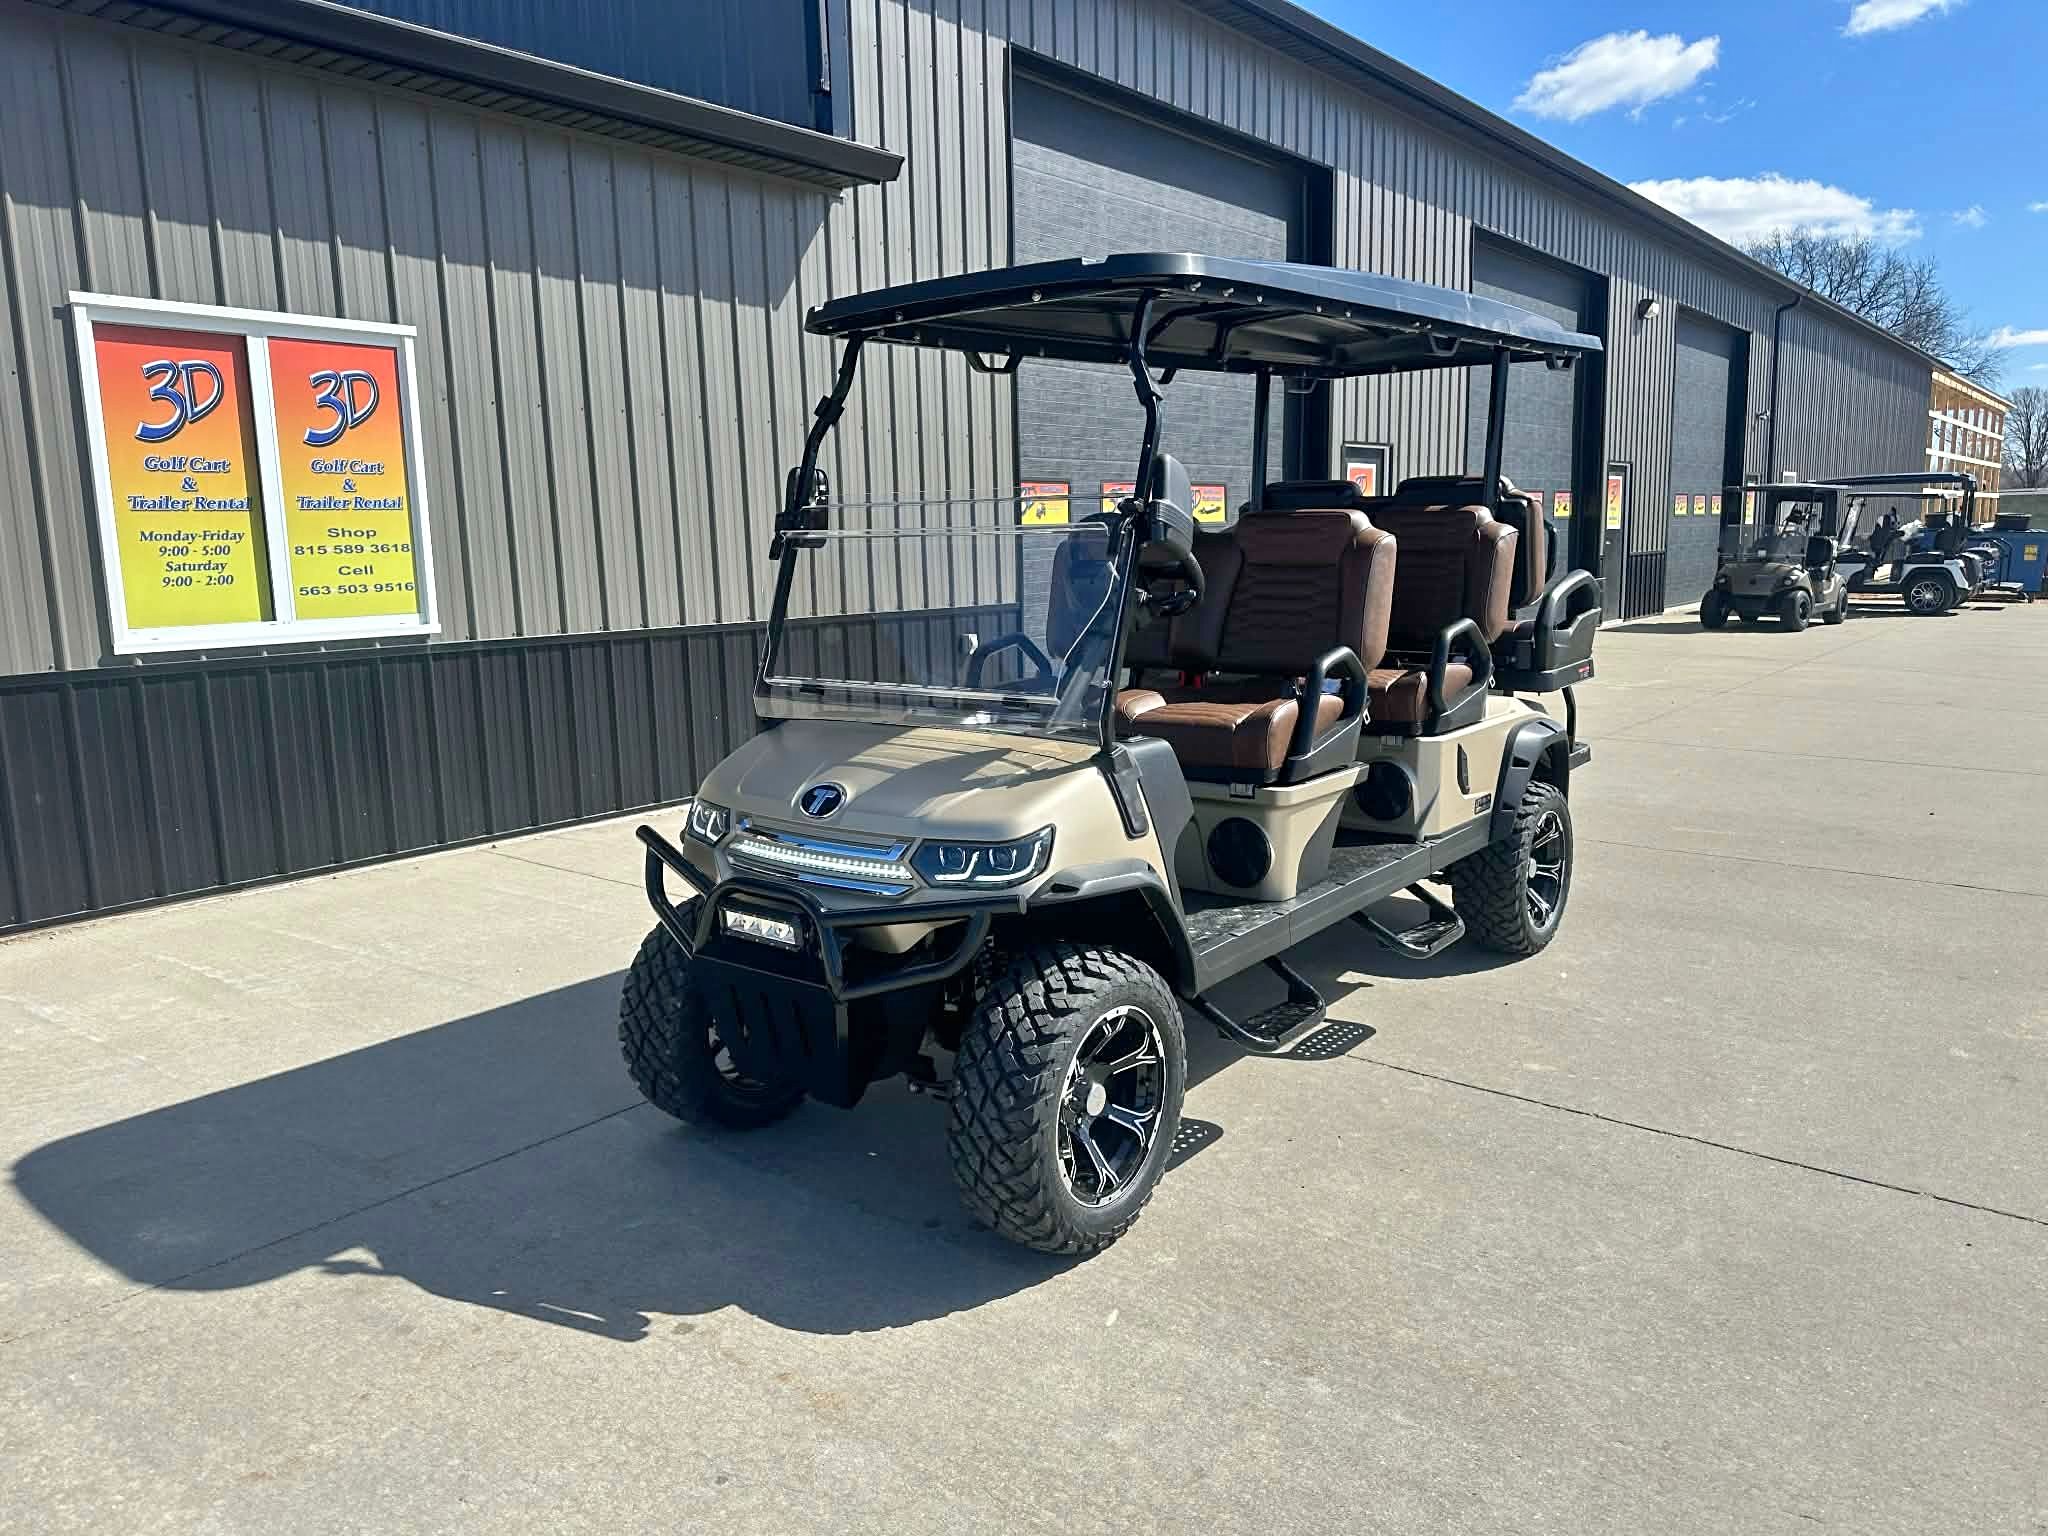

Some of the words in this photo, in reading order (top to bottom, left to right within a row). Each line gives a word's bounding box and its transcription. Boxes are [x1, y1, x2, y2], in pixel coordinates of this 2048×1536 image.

[135, 359, 224, 442] 3D
[303, 370, 380, 446] 3D
[144, 456, 187, 471] Golf
[189, 457, 230, 473] Cart
[311, 459, 348, 474] Golf
[349, 460, 385, 475] Cart
[181, 476, 198, 492] &
[343, 478, 357, 492] &
[128, 495, 191, 511] Trailer
[193, 496, 253, 511] Rental
[296, 496, 351, 511] Trailer
[352, 496, 403, 511] Rental
[140, 530, 245, 544] Monday-Friday
[327, 528, 377, 539] Shop
[159, 545, 189, 557] 9:00
[202, 545, 231, 556] 5:00
[294, 545, 328, 555] 815
[333, 544, 364, 554] 589
[370, 543, 410, 553] 3618
[165, 560, 227, 574] Saturday
[338, 565, 374, 575] Cell
[162, 575, 192, 587] 9:00
[205, 574, 234, 586] 2:00
[299, 586, 331, 596] 563
[337, 584, 369, 594] 503
[373, 582, 414, 592] 9516
